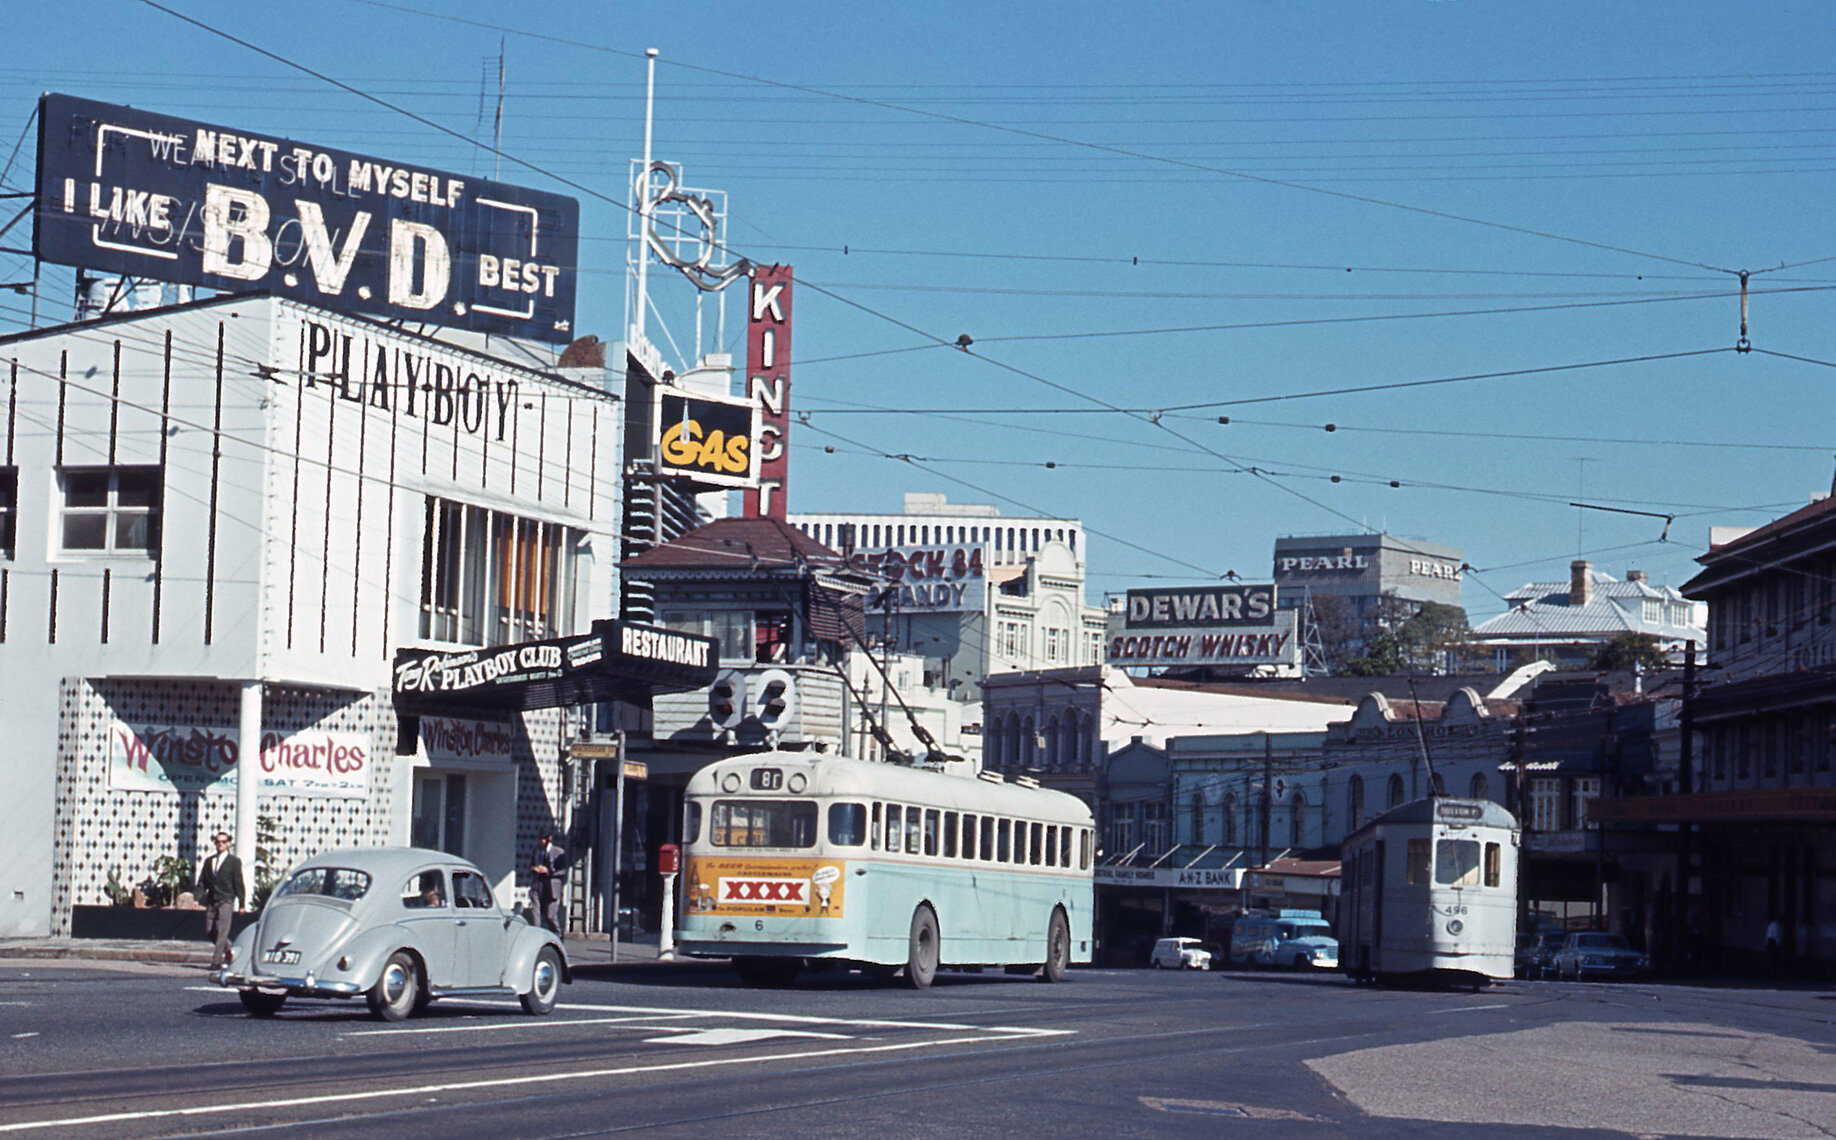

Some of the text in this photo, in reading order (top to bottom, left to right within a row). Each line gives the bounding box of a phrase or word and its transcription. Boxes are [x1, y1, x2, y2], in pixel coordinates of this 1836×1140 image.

[196, 129, 464, 208] NEXT TO MYSELF
[65, 178, 75, 213] I
[90, 182, 171, 229] LIKE
[479, 254, 560, 297] BEST
[305, 321, 517, 441] PLAYBOY
[661, 419, 749, 473] GAS
[952, 548, 984, 578] 84
[1282, 555, 1369, 572] PEARL
[1409, 559, 1463, 582] PEARL
[1129, 588, 1271, 622] DEWAR'S
[621, 626, 710, 668] RESTAURANT
[1109, 630, 1293, 659] SCOTCH WHISKY
[440, 649, 518, 690] PLAYBOY
[519, 645, 562, 668] CLUB
[117, 726, 367, 776] Winsto Charles
[158, 773, 207, 785] OPEN
[264, 777, 296, 788] SAT
[725, 881, 804, 901] XXXX
[1205, 872, 1231, 885] BANK
[755, 919, 764, 931] 6
[1445, 906, 1468, 915] 496
